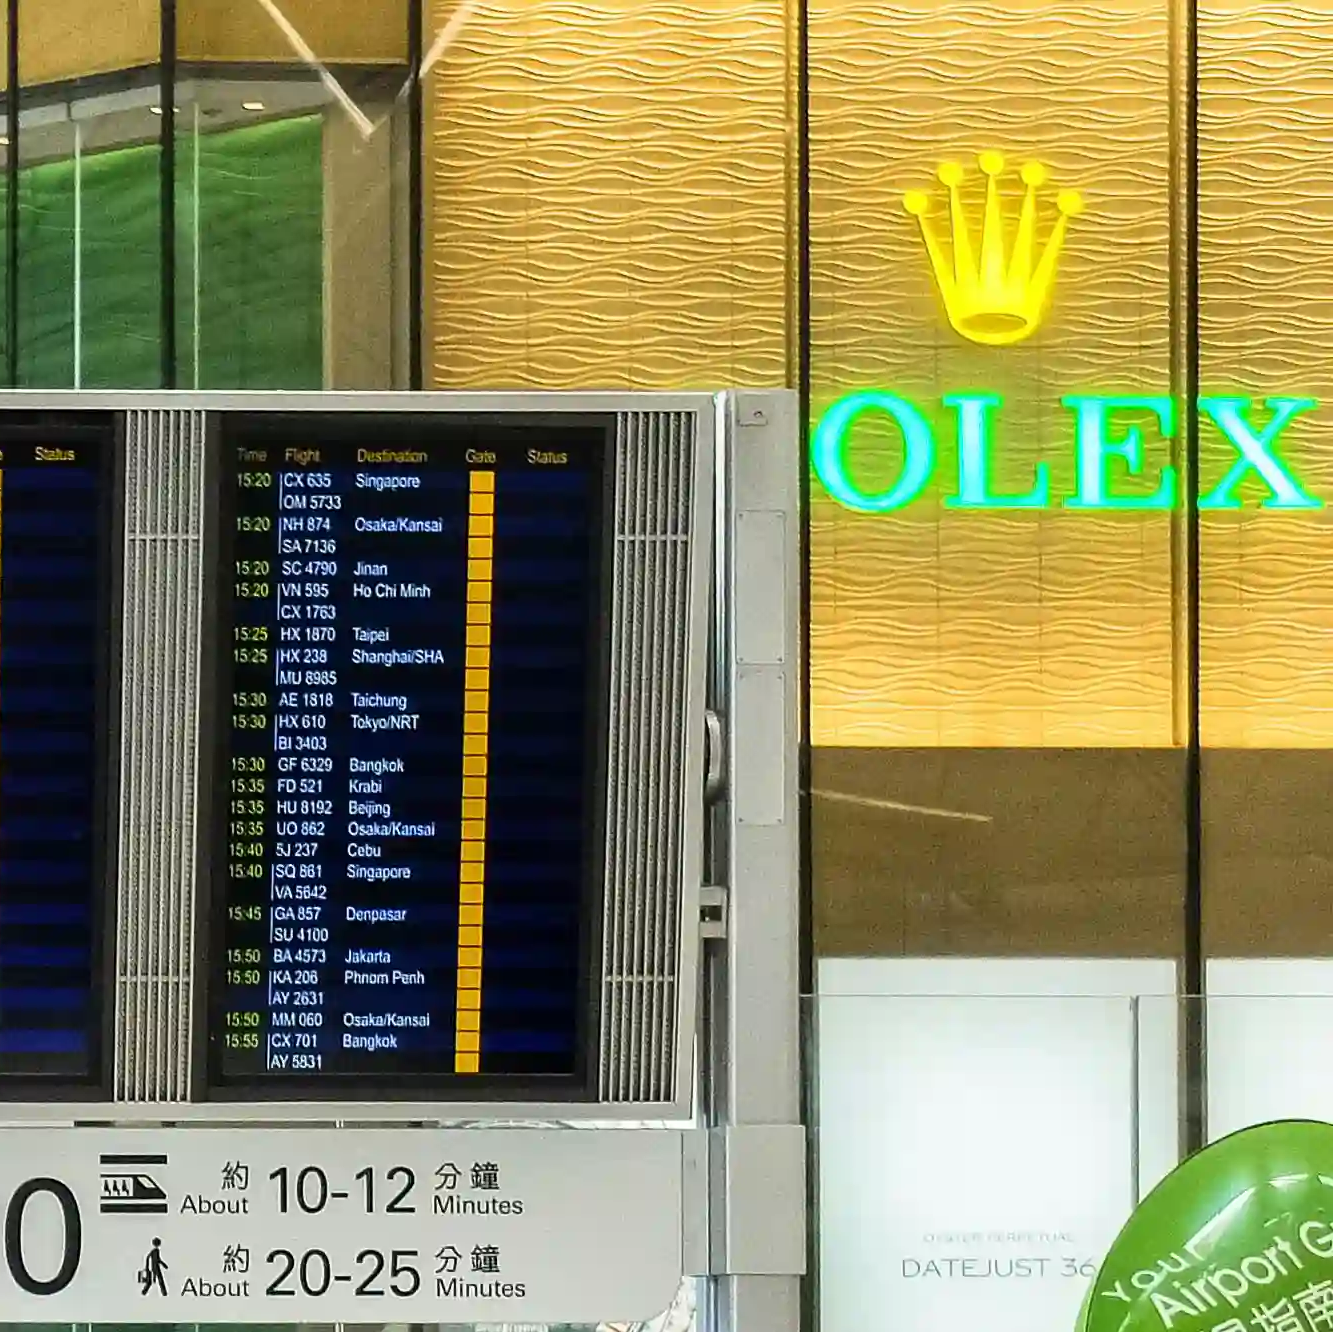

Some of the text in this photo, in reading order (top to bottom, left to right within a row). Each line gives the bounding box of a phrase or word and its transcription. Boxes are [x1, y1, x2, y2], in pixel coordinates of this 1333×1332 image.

[236, 560, 388, 576] 15:20 SC 4790 Jinan
[236, 582, 431, 598] 15:20 VN 595 Ho Chi Minh
[349, 779, 382, 794] Krabi
[347, 842, 381, 857] Cebu
[221, 1160, 500, 1191] 約 分鐘
[180, 1165, 524, 1215] About 10-12 Minutes
[222, 1243, 501, 1274] 約 分鐘
[900, 1257, 1098, 1279] DATEJUST 36
[180, 1249, 526, 1298] About 20-25 Minutes
[1150, 1220, 1333, 1330] Airport G
